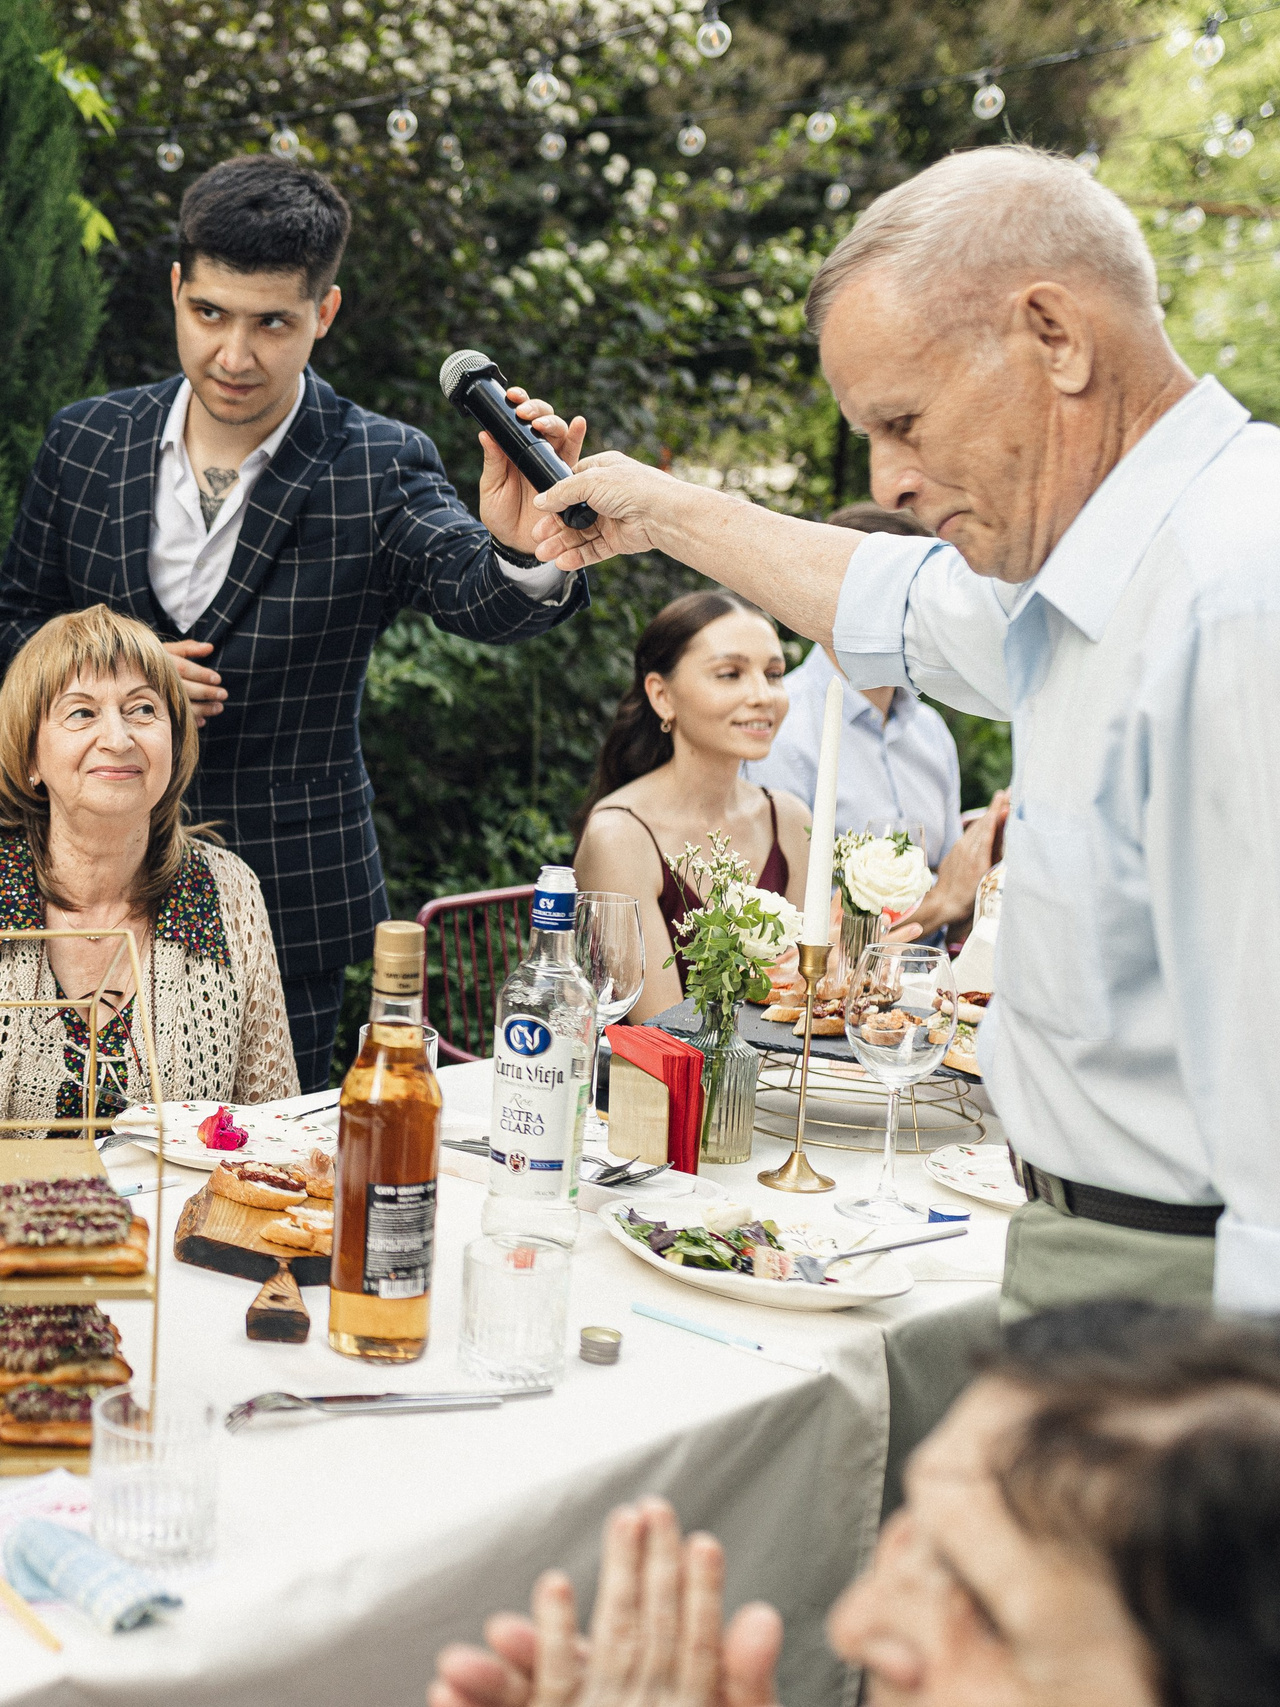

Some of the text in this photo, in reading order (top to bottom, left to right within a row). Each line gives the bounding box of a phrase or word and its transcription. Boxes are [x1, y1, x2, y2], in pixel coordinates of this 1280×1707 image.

[509, 1023, 544, 1051] CV
[526, 1063, 564, 1092] Vieja
[502, 1106, 545, 1125] EXTRA
[500, 1118, 545, 1137] CLARO
